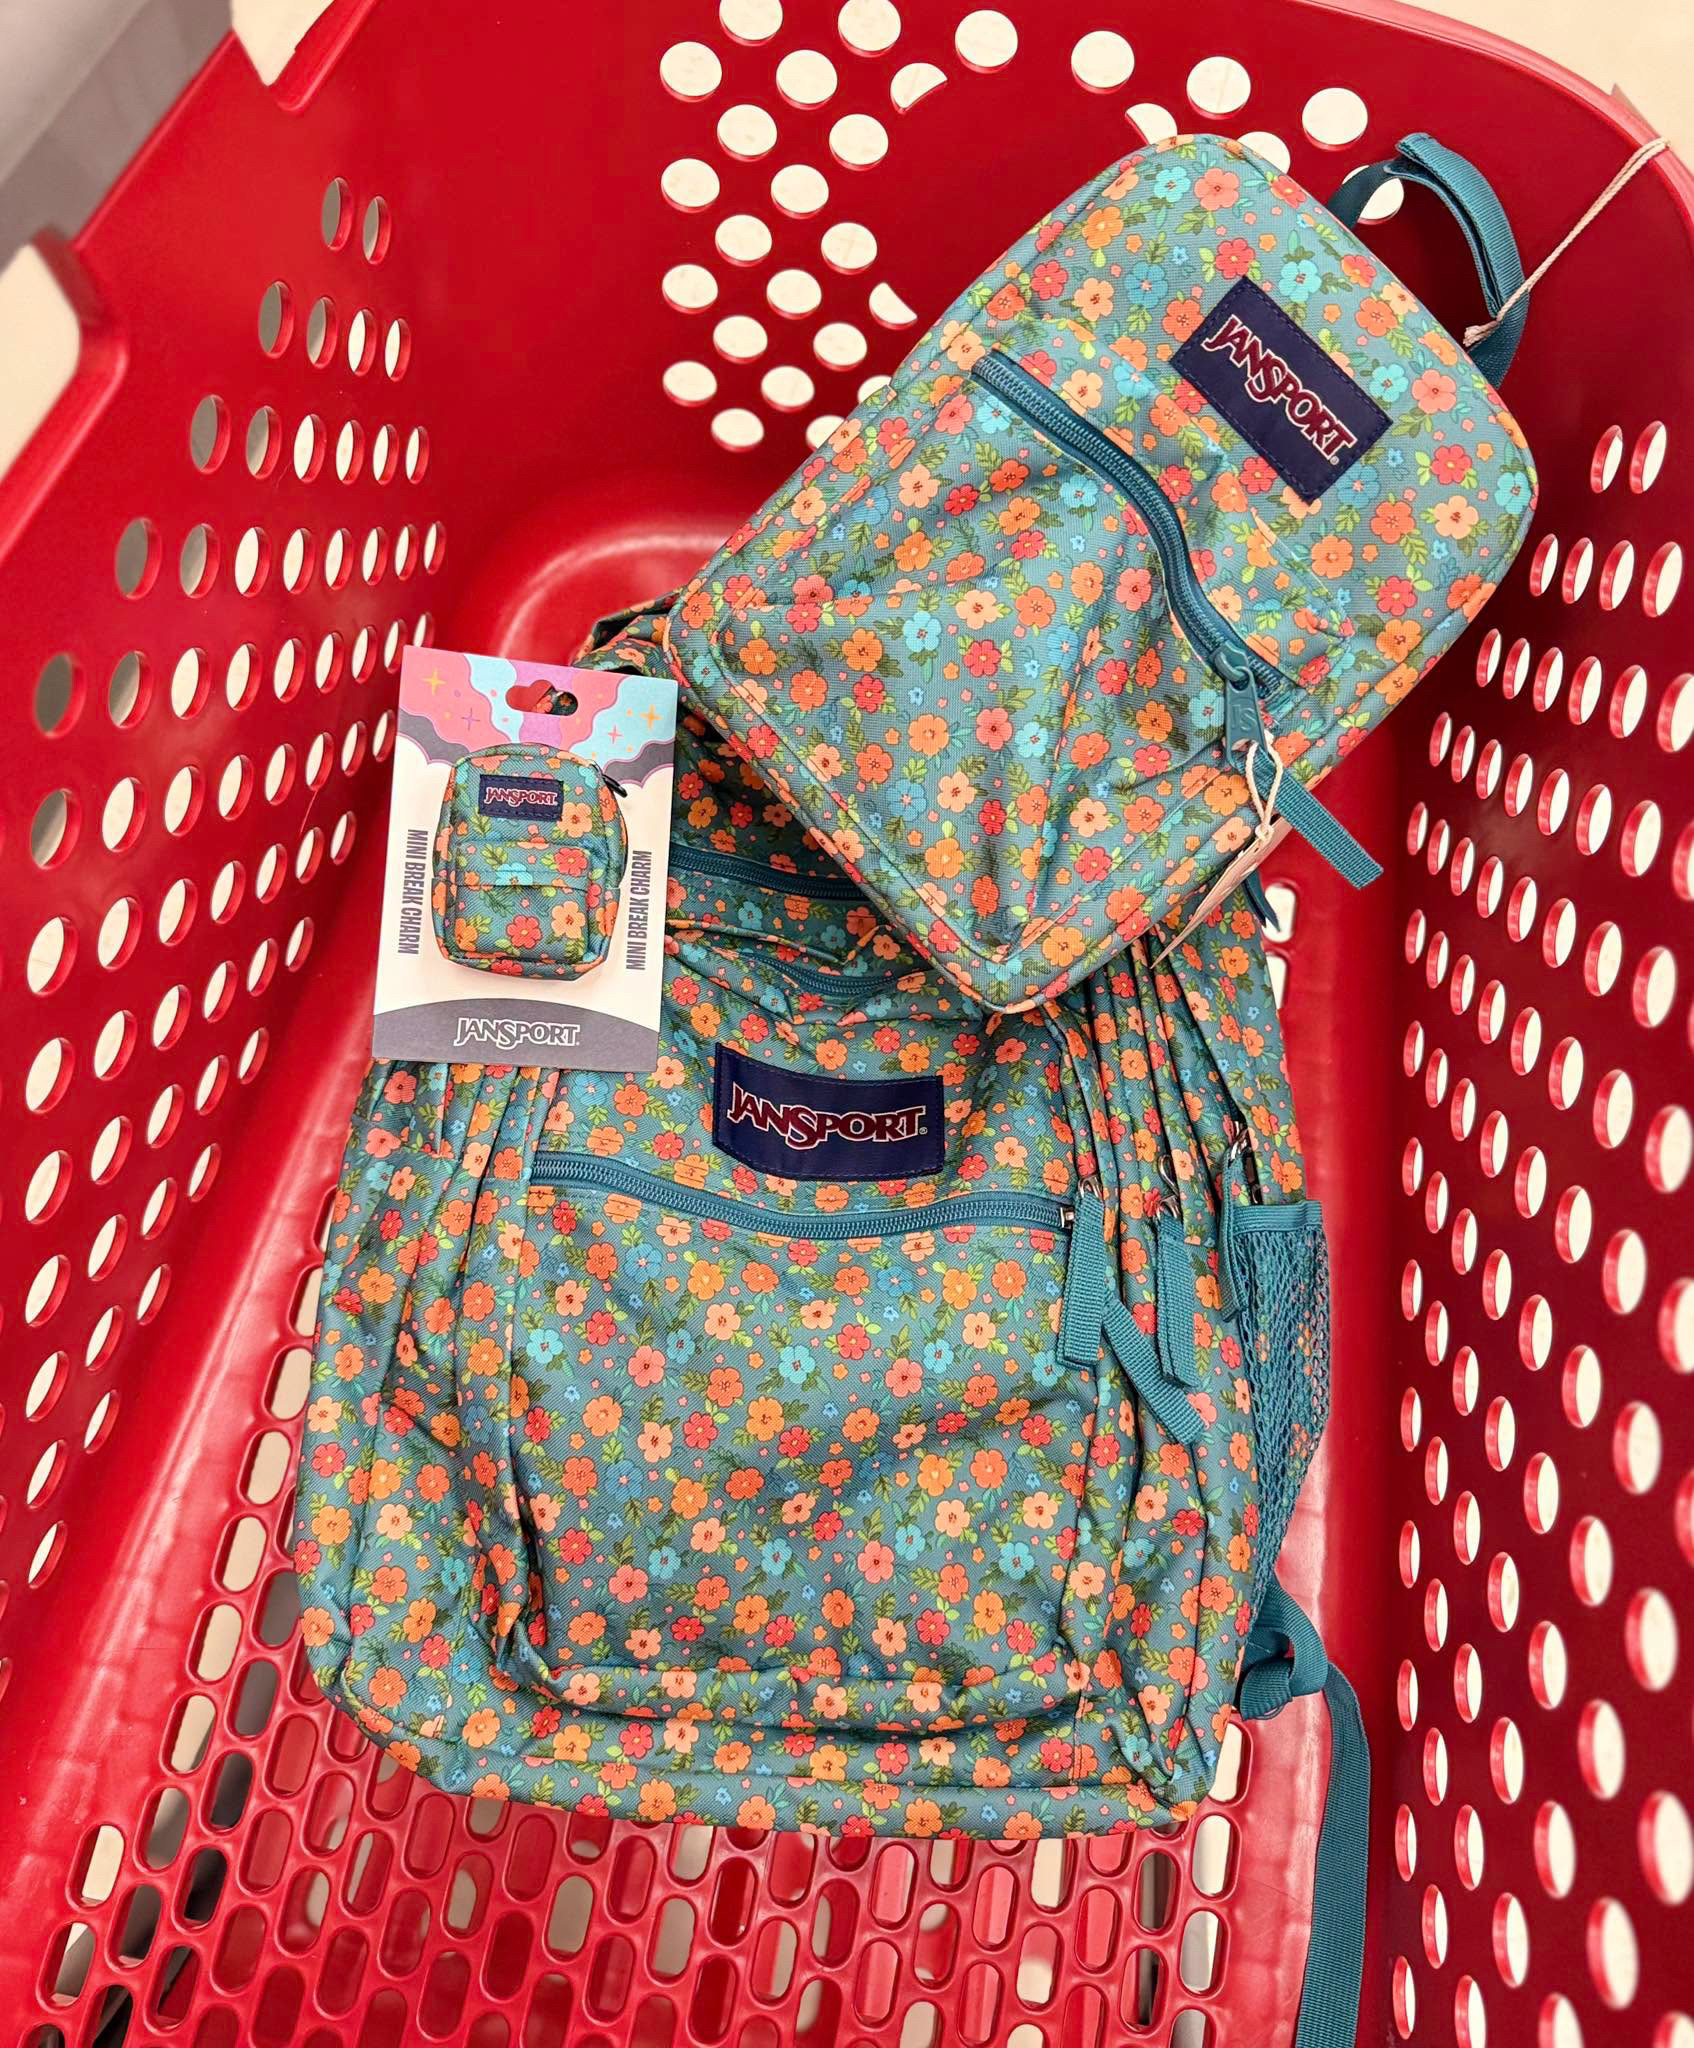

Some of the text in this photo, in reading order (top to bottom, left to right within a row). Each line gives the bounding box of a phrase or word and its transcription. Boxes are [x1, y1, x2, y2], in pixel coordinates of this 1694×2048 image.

[398, 829, 428, 954] MINI BREAK CHARM
[626, 850, 652, 970] MINI BREAK CHARM
